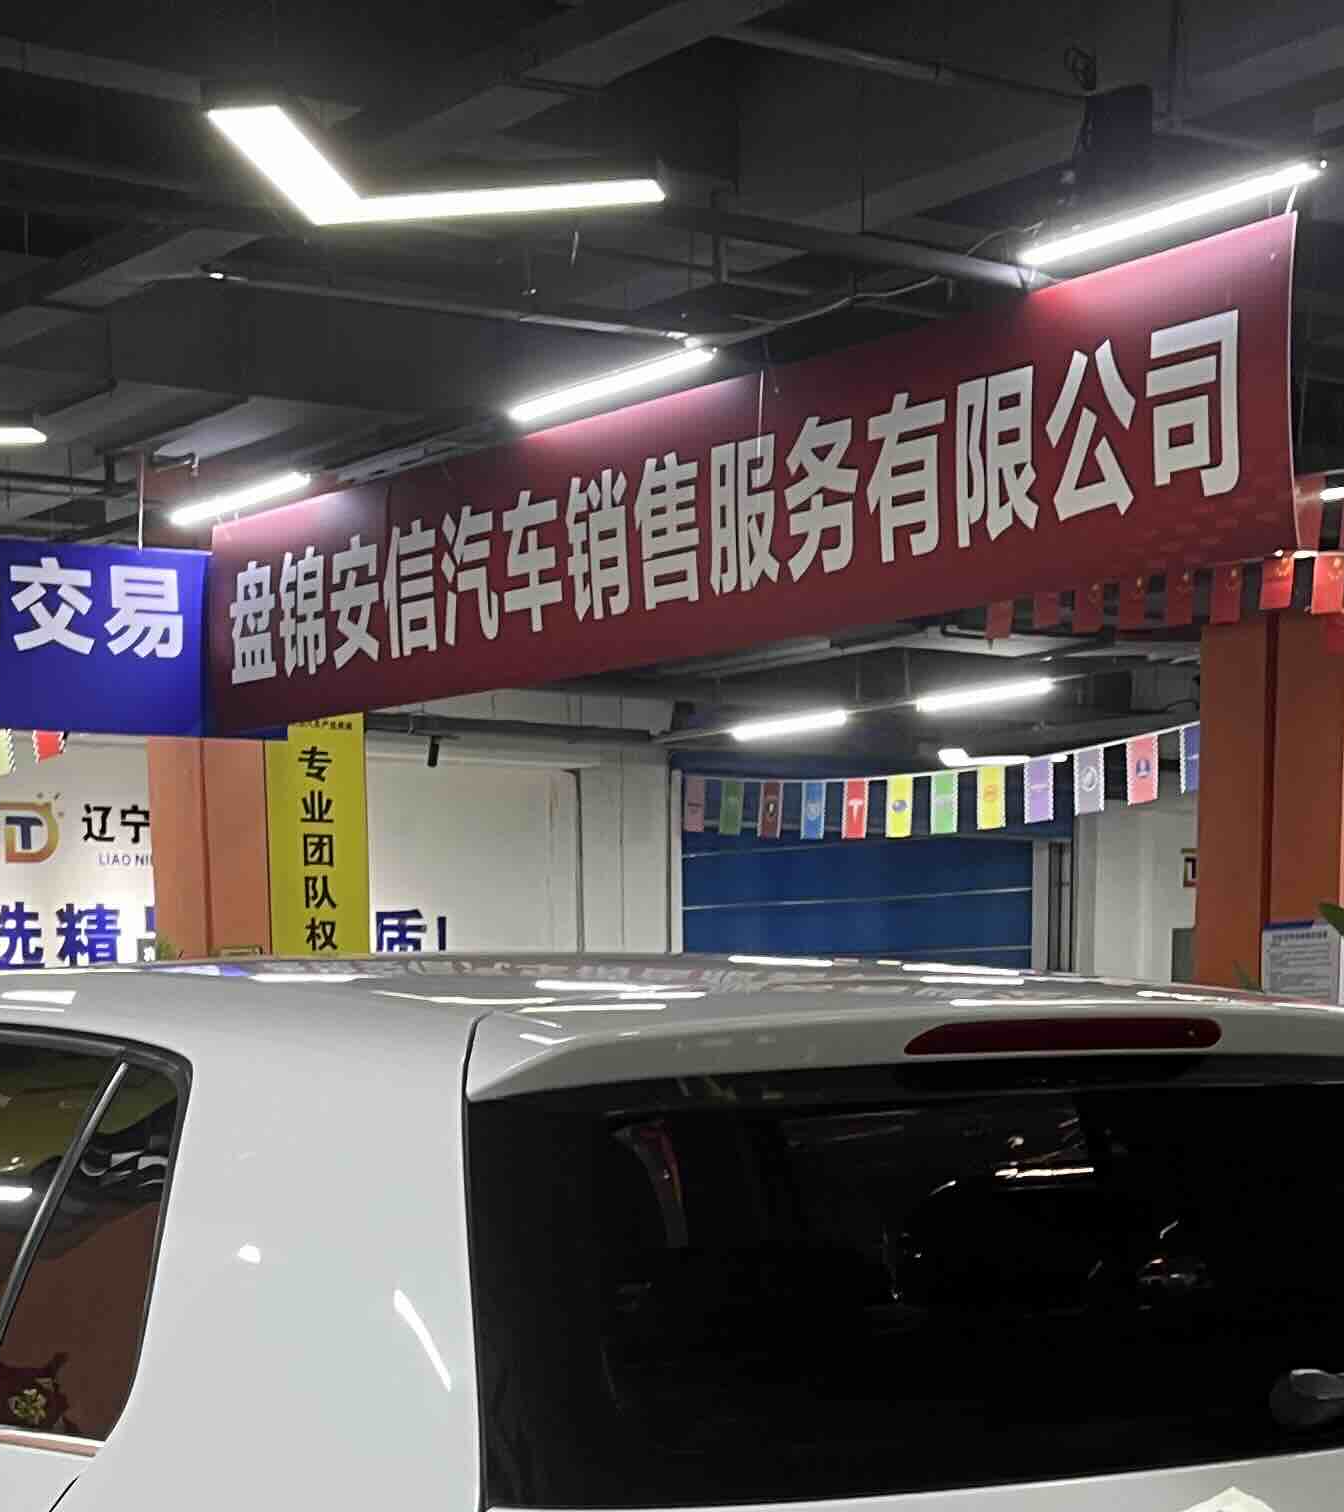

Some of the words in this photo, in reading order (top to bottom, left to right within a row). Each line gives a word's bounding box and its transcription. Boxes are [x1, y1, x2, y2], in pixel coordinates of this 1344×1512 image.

[229, 309, 1241, 686] 盘锦安信汽车销售服务有限公司
[81, 803, 150, 845] 辽宁
[98, 853, 131, 866] LIAO
[297, 745, 339, 951] 专业团队权
